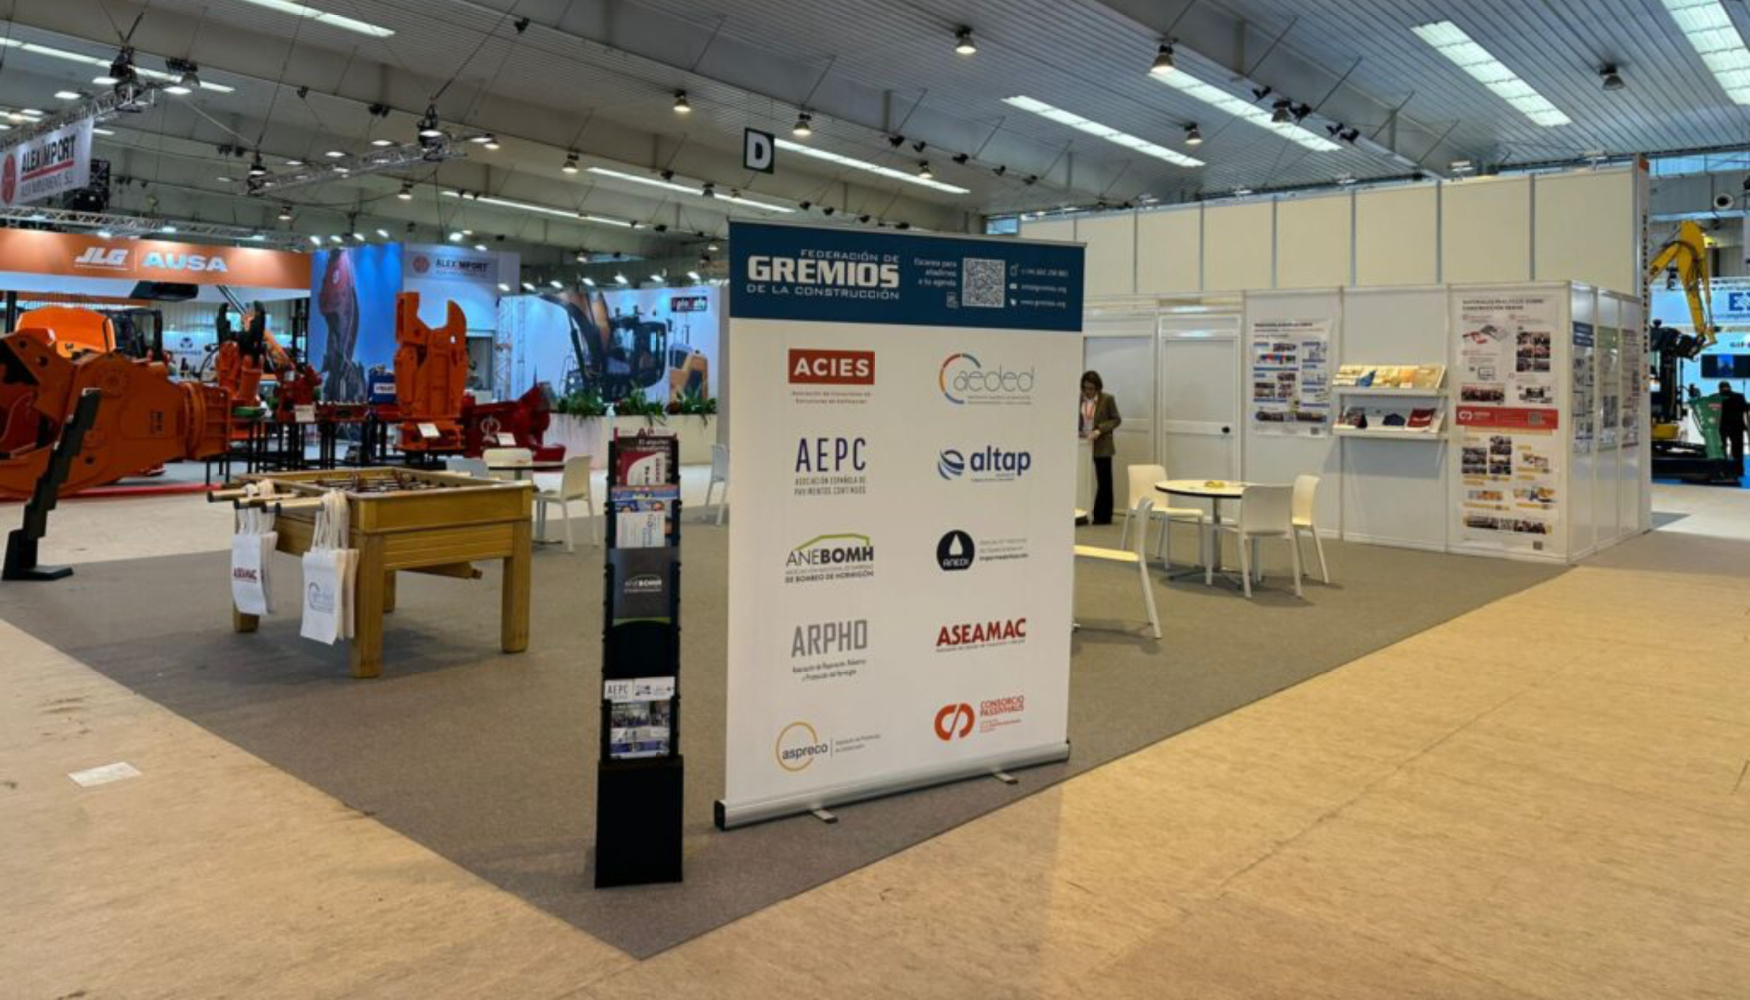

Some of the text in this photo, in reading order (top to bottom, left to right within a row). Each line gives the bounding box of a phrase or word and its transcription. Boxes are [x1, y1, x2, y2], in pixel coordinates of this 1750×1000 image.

[746, 131, 771, 170] D
[75, 246, 229, 273] JLG AUSA
[801, 249, 899, 263] FEDERACIÓN DE
[748, 255, 900, 288] GREMIOS
[746, 284, 900, 300] DE LA CONSTRUCCIÓN
[793, 357, 870, 377] ACIES
[954, 364, 1035, 392] aeded
[795, 437, 866, 472] AEPC
[970, 445, 1031, 476] altap
[786, 546, 874, 567] ANEBOMH
[791, 619, 867, 658] ARPHO
[936, 618, 1026, 647] ASEAMAC
[981, 695, 1024, 708] CONSORCIO
[782, 743, 828, 760] aspreco
